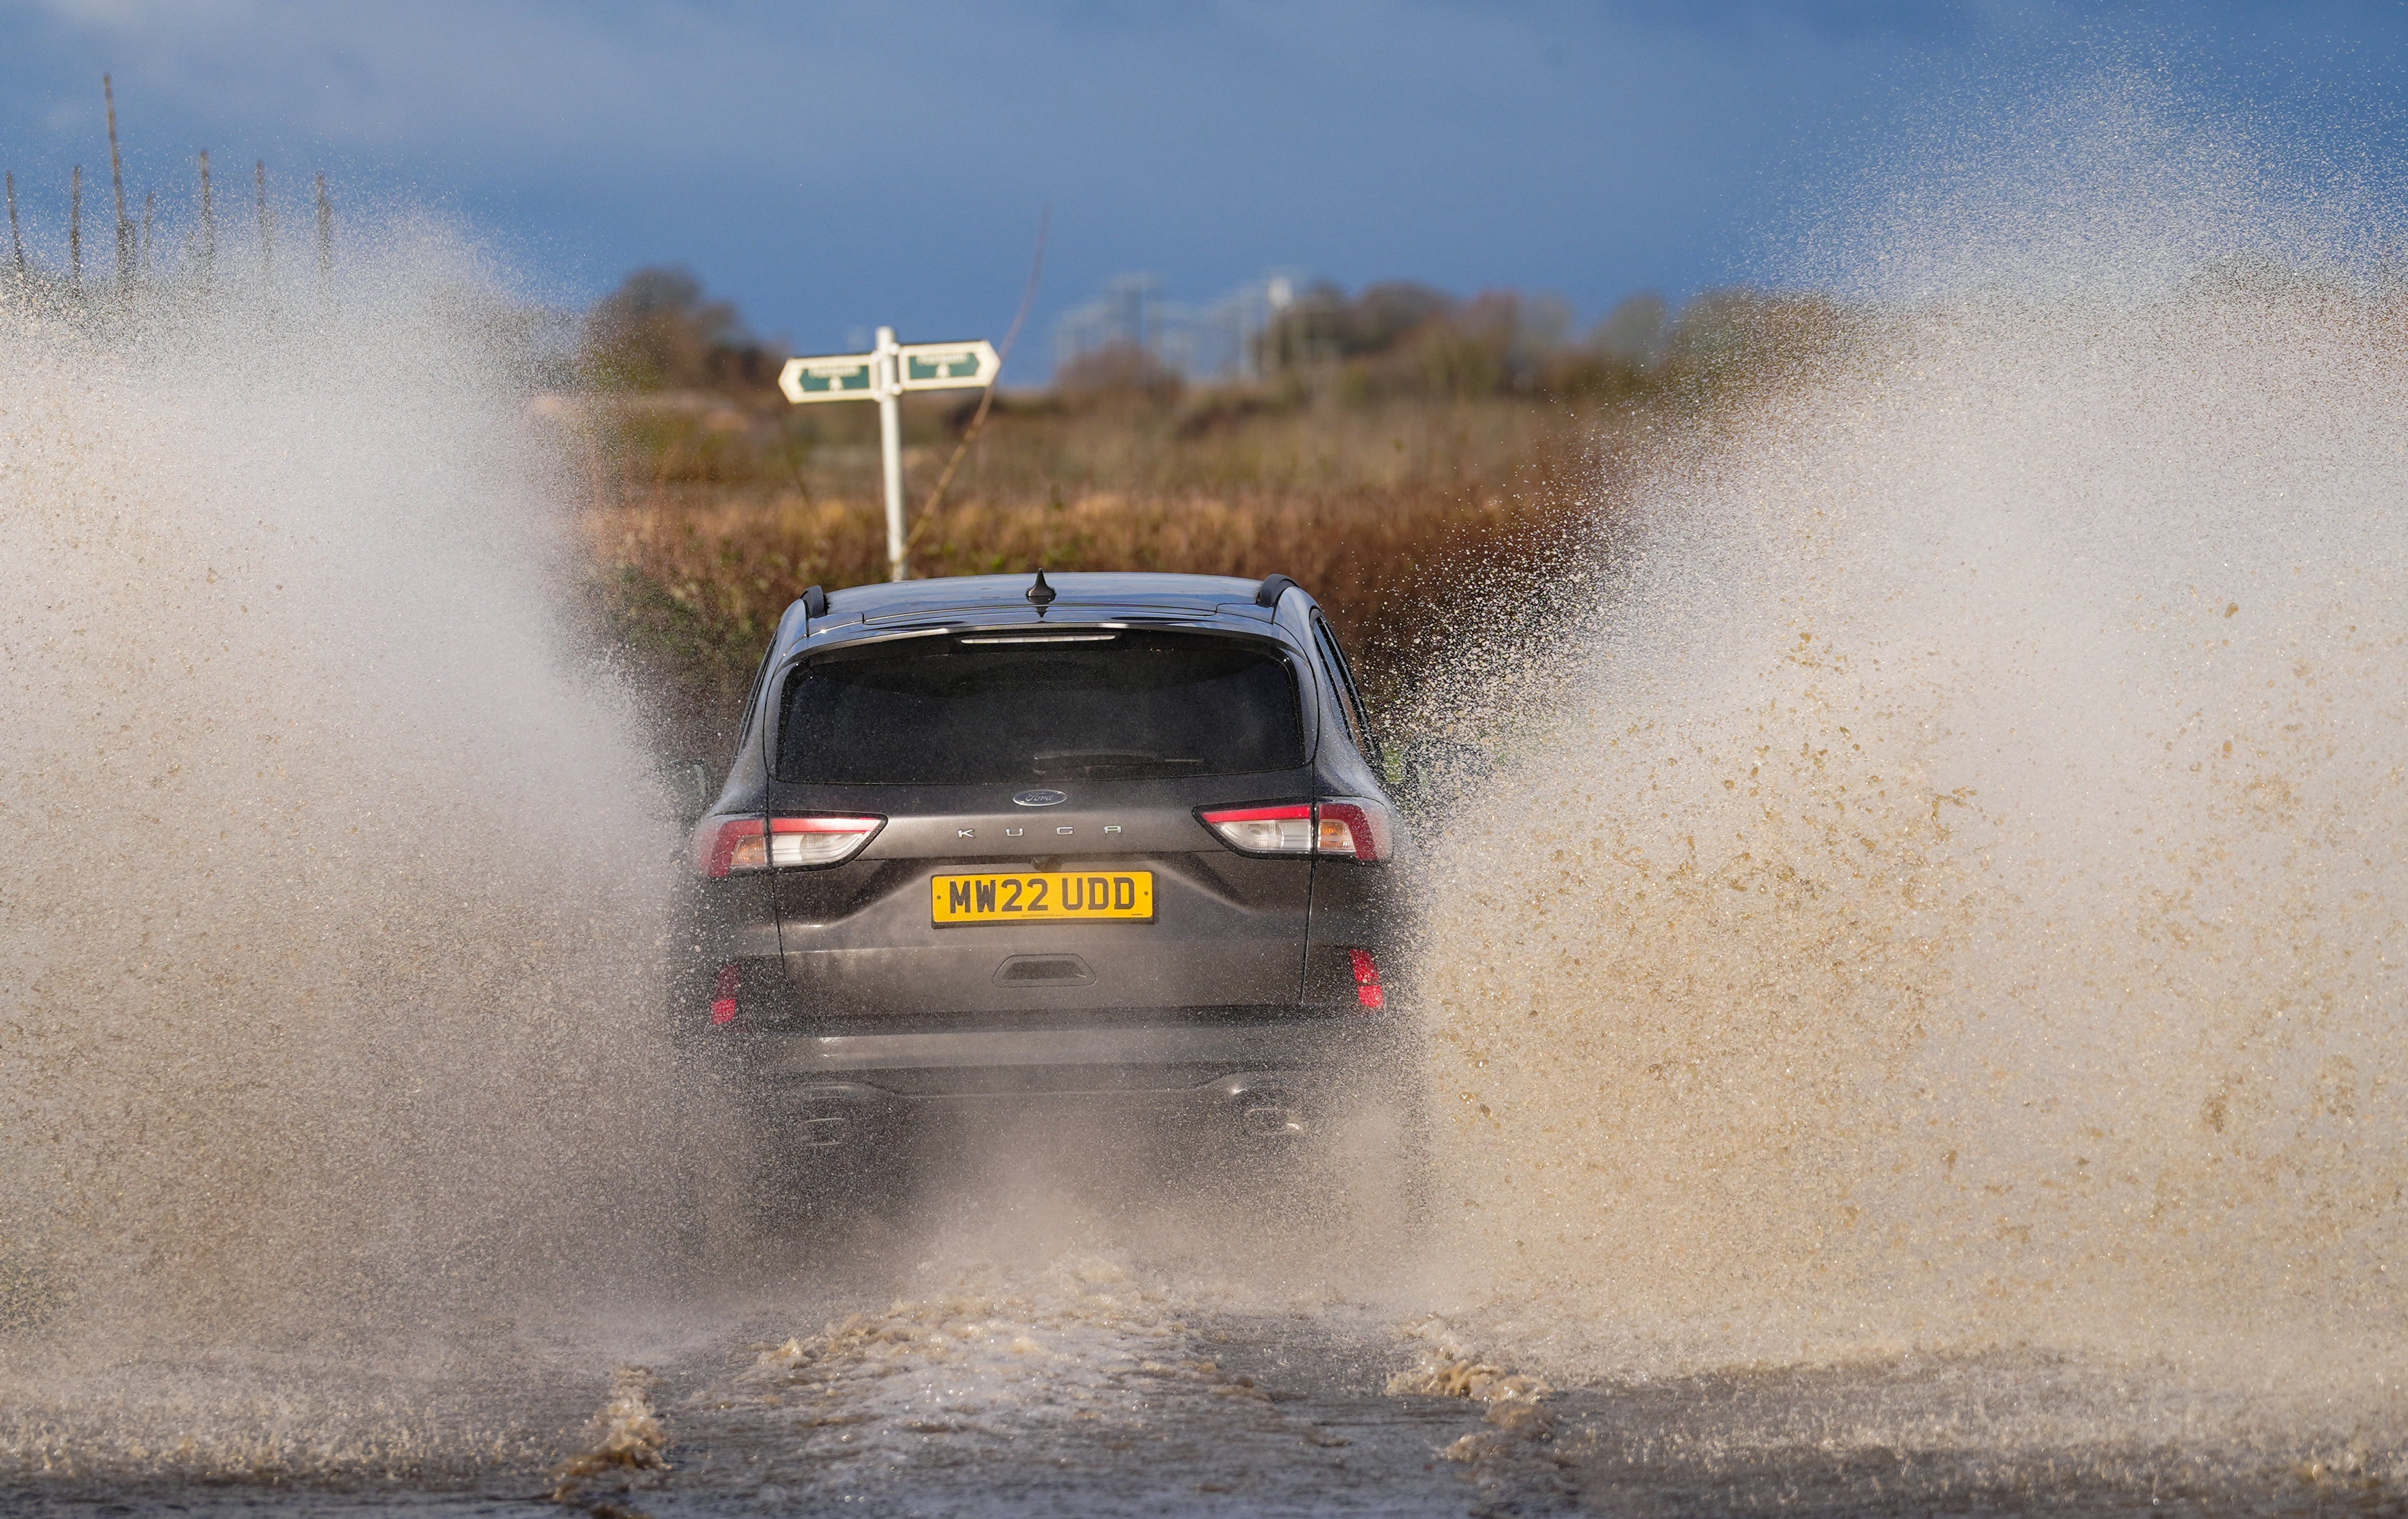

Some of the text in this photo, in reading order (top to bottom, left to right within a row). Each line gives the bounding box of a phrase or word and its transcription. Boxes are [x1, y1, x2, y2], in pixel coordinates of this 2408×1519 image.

[1025, 792, 1054, 802] Ford
[958, 825, 1122, 838] KUGA
[949, 877, 1135, 914] MW22 UDD
